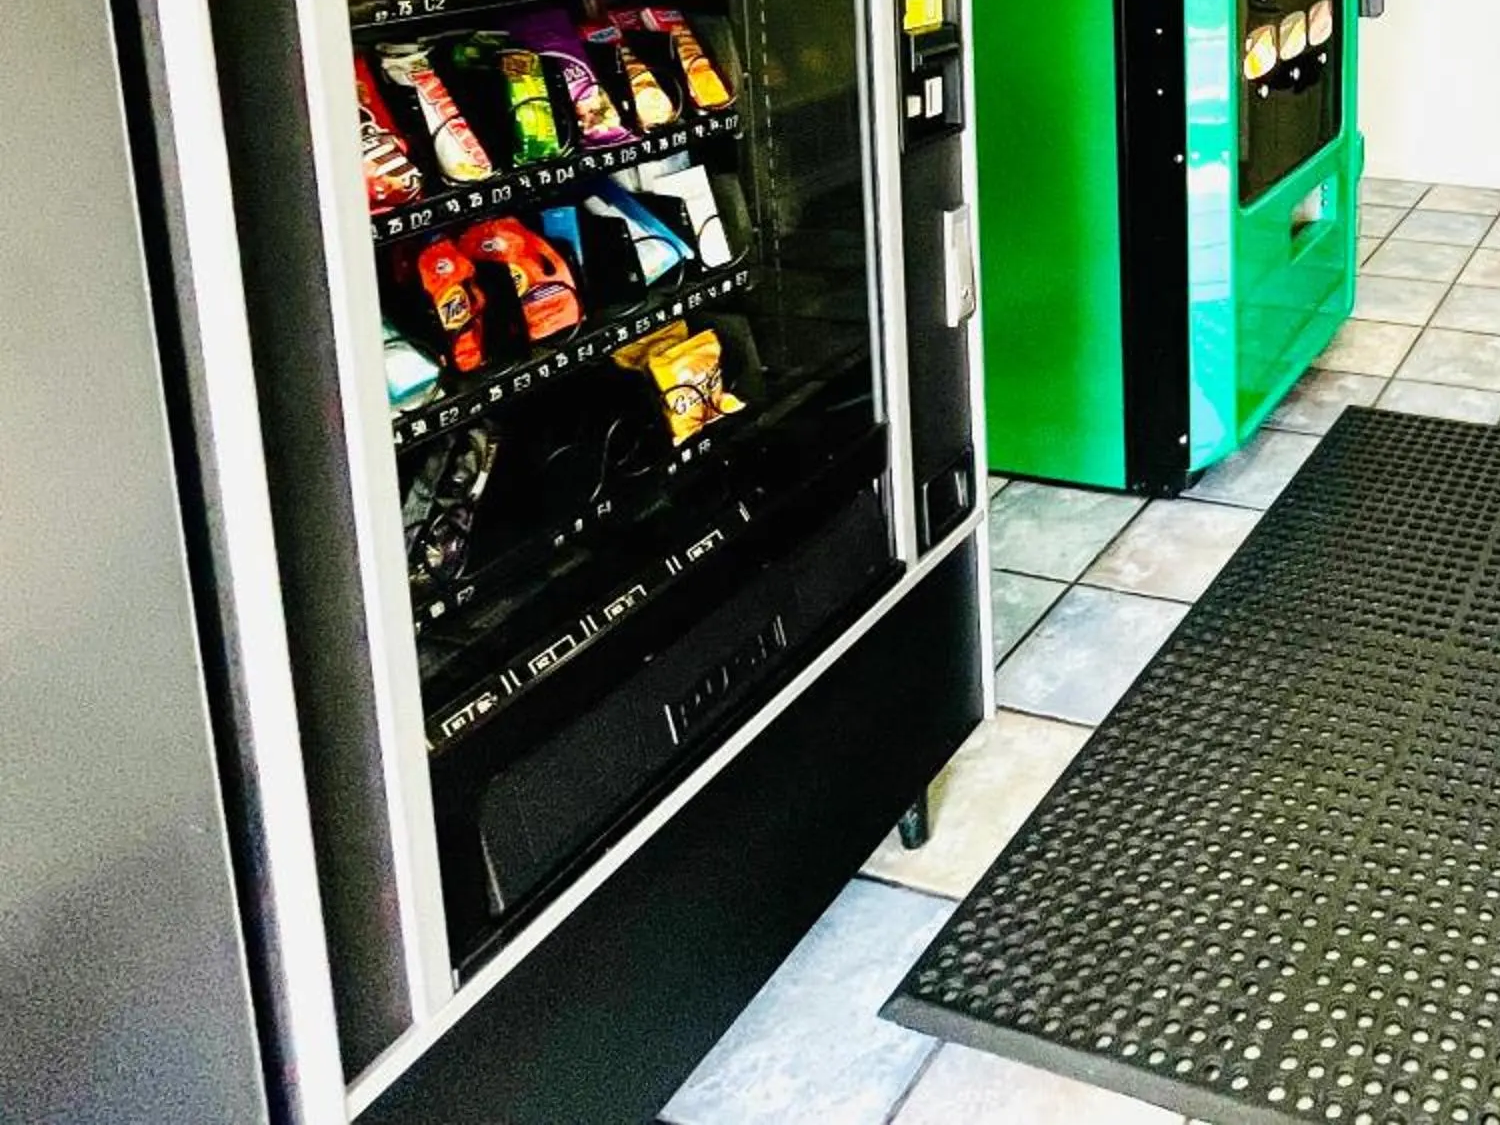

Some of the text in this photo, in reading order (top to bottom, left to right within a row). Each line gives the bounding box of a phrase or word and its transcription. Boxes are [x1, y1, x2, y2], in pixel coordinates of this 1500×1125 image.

[620, 146, 638, 164] D5
[556, 165, 575, 184] D4
[490, 185, 512, 204] D3
[410, 209, 433, 230] D2
[635, 316, 651, 334] E5
[577, 344, 595, 362] E4
[513, 373, 532, 392] E3
[439, 407, 460, 427] E2
